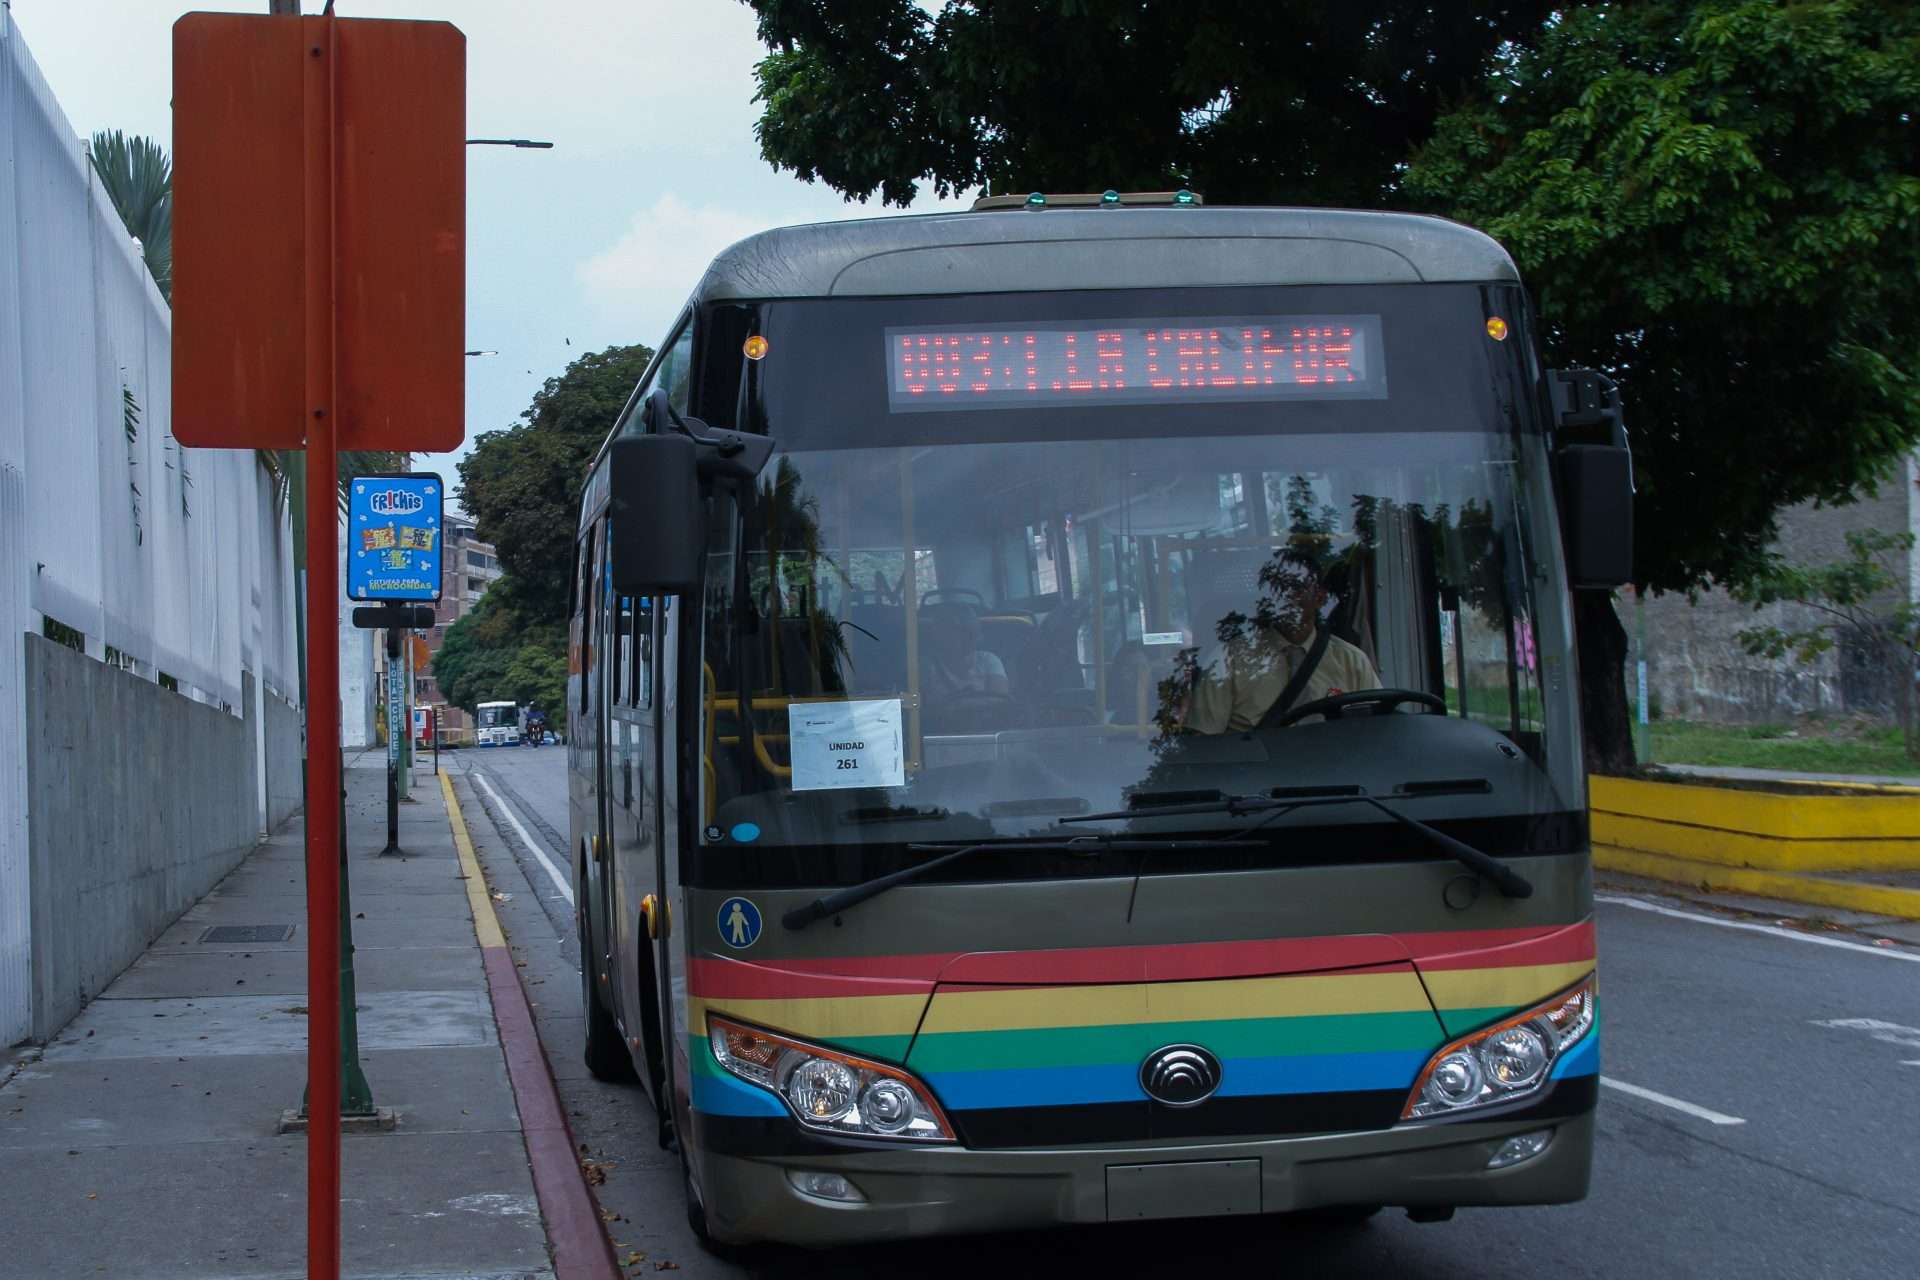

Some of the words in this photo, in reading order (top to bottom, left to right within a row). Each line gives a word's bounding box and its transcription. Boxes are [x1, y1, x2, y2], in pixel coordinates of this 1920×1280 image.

[1146, 326, 1355, 388] CALIFOR
[369, 582, 432, 590] MICROONDAS
[829, 741, 865, 751] UNIDAD
[836, 758, 859, 770] 261
